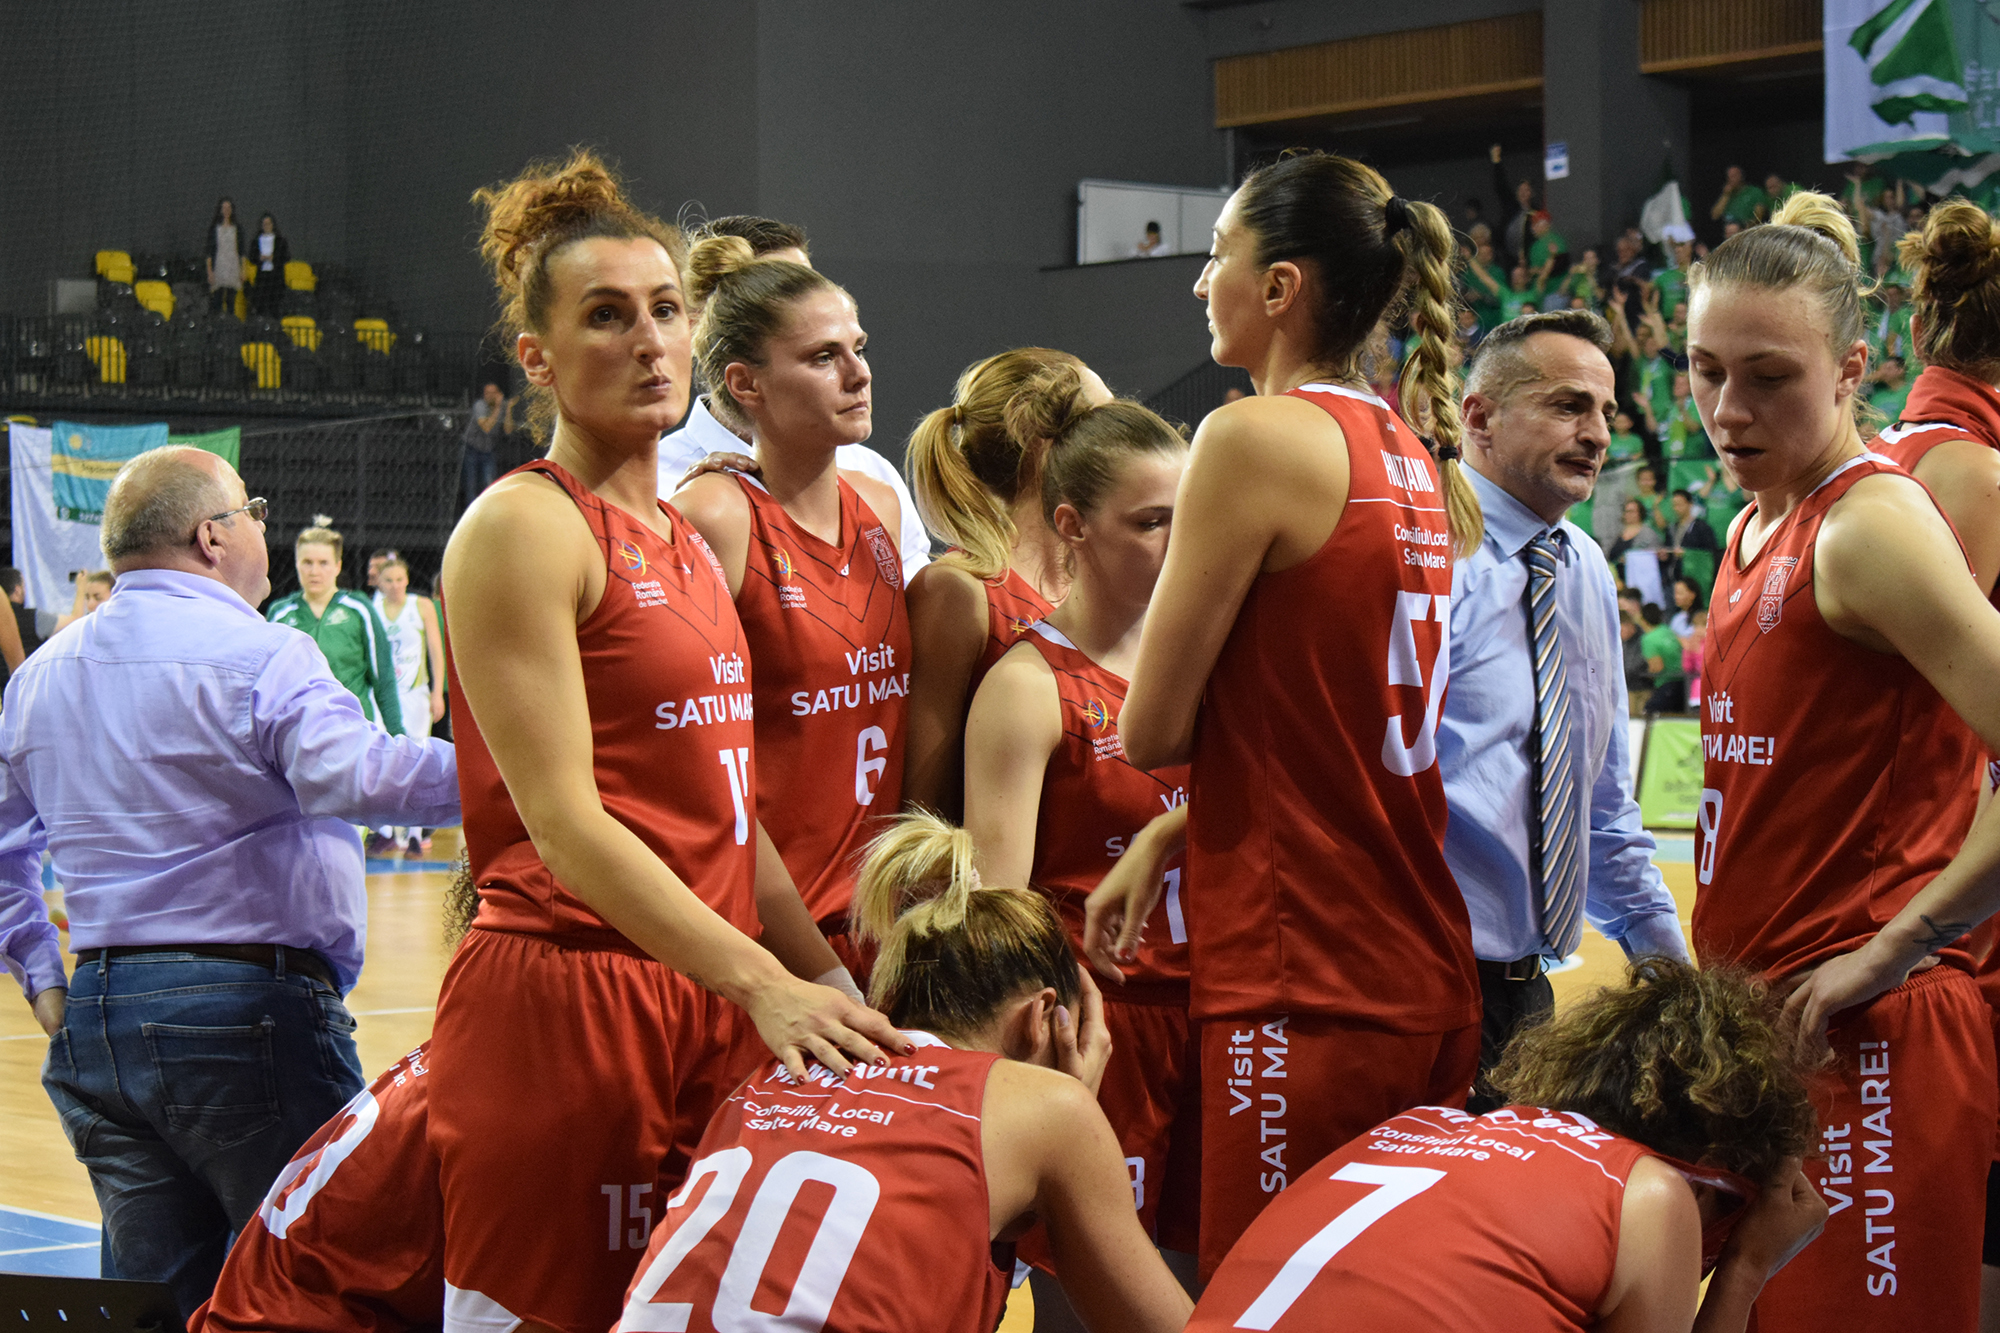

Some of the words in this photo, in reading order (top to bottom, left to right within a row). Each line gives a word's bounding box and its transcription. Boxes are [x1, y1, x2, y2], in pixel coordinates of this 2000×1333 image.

[1394, 523, 1429, 545] Consiliul
[1404, 548, 1423, 567] Satu
[1423, 551, 1446, 569] Mare
[709, 652, 746, 684] Visit
[845, 643, 895, 676] Visit
[655, 694, 727, 730] SATU
[791, 683, 861, 717] SATU
[1707, 691, 1734, 724] Visit
[855, 725, 888, 806] 6
[1698, 788, 1723, 886] 8
[1227, 1029, 1255, 1117] Visit
[828, 1103, 895, 1126] Local
[1859, 1040, 1894, 1174] MARE!
[745, 1117, 796, 1131] Satu
[796, 1115, 858, 1138] Mare
[1260, 1093, 1288, 1193] SATU
[1367, 1140, 1425, 1155] Satu
[1425, 1146, 1491, 1161] Mare
[1464, 1134, 1537, 1162] Local
[1819, 1123, 1854, 1216] Visit
[601, 1182, 653, 1251] 15
[616, 1146, 881, 1333] 20
[1233, 1162, 1448, 1331] 7
[1864, 1189, 1898, 1297] SATU
